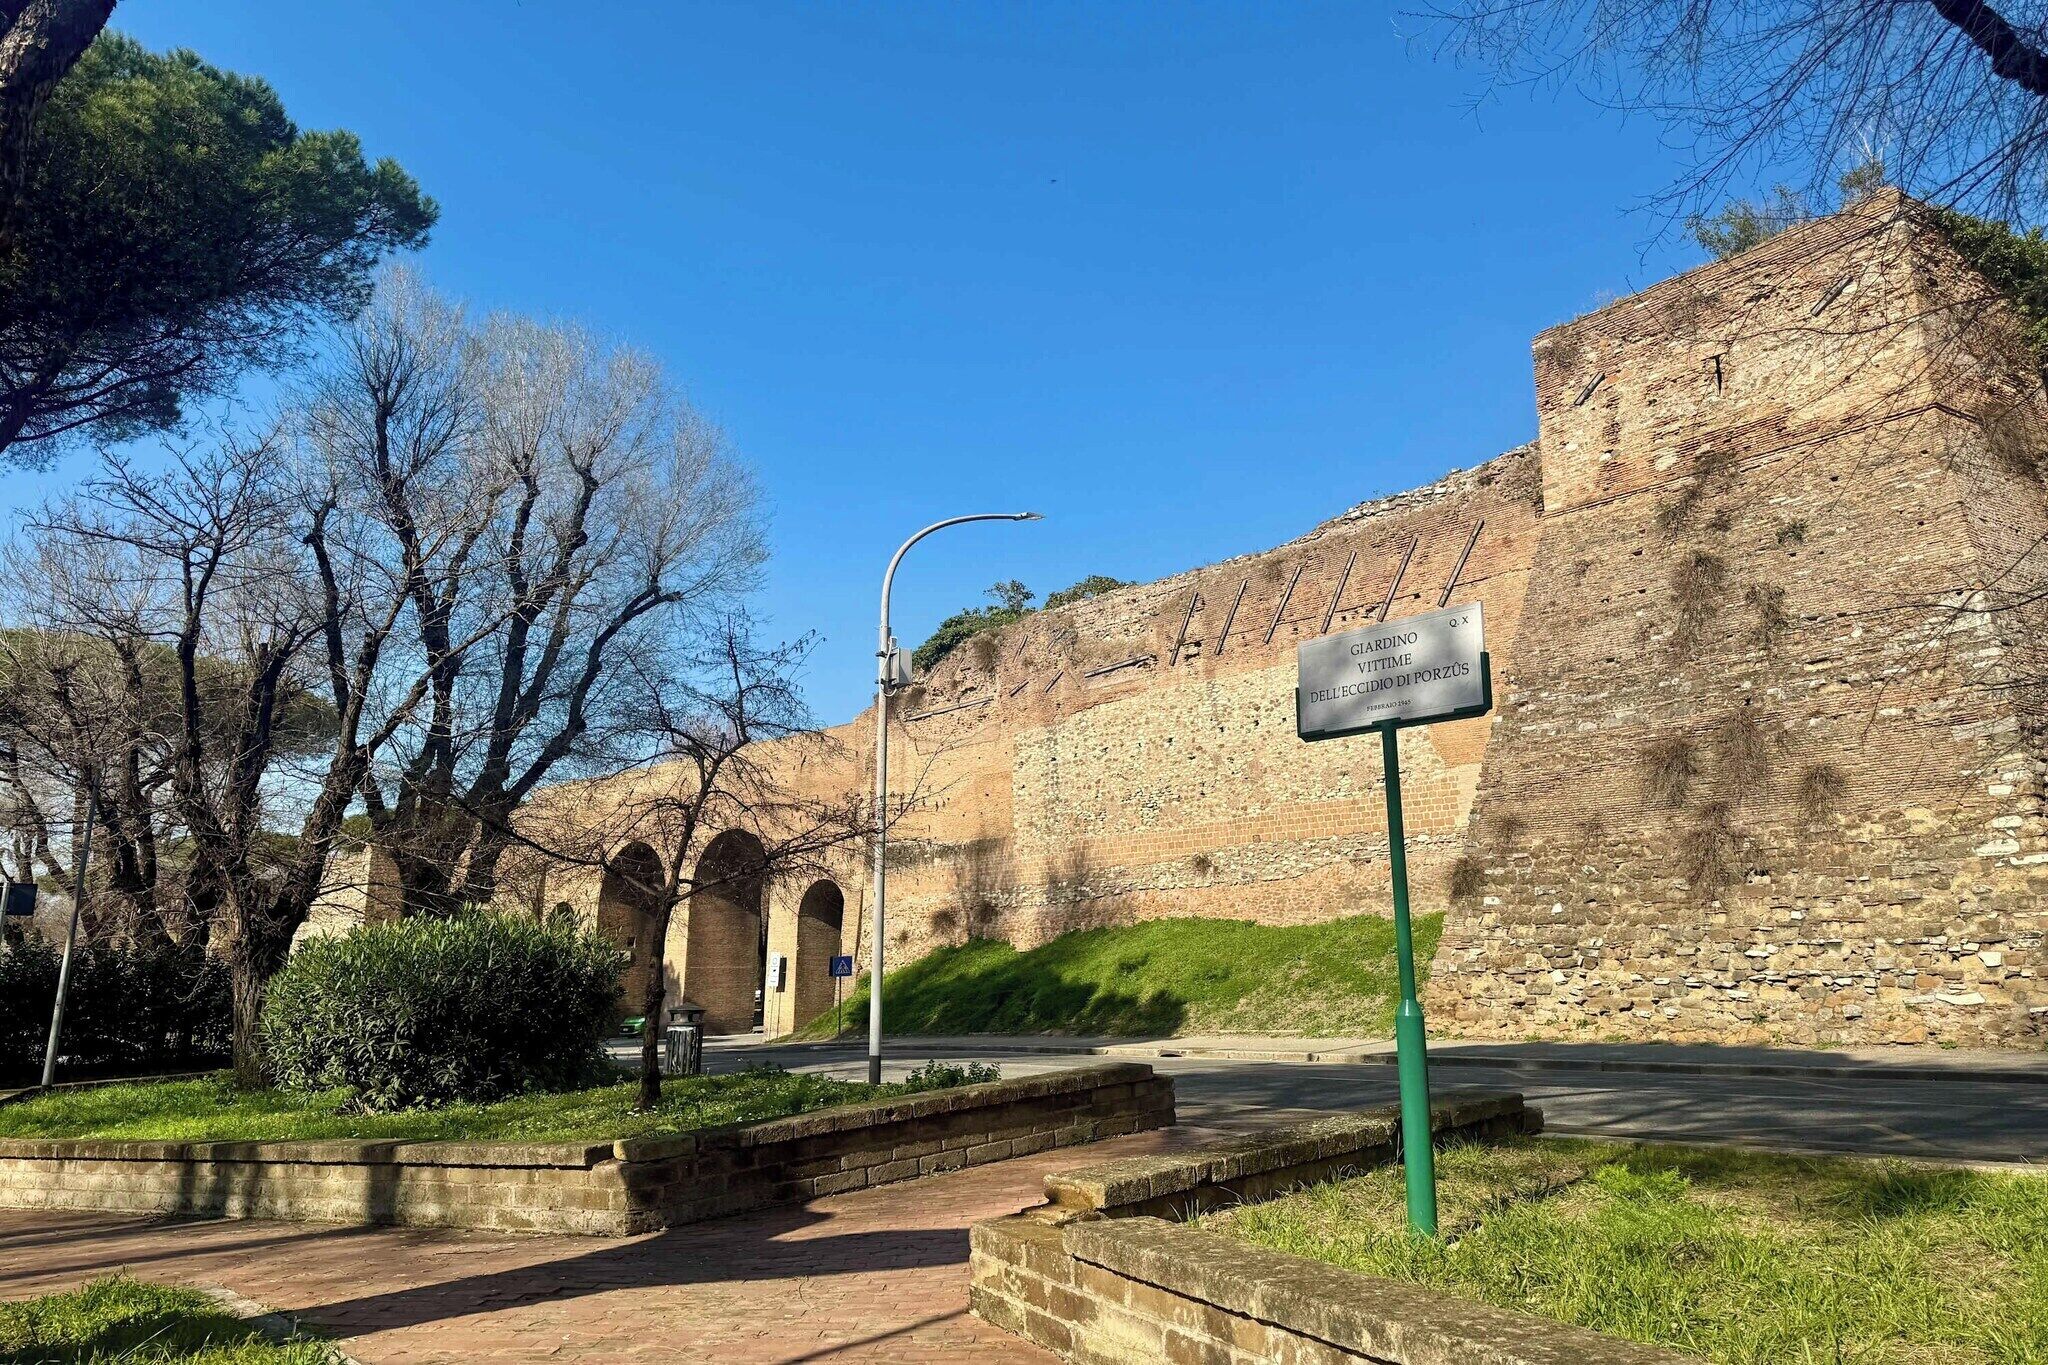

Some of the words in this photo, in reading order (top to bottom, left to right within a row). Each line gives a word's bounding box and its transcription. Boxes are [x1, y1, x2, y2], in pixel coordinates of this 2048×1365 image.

[1449, 618, 1460, 627] Q.
[1461, 615, 1469, 624] X
[1350, 631, 1418, 656] GIARDINO
[1357, 653, 1412, 674] VITTIME
[1310, 676, 1394, 704] DELL'ECCIDIO
[1396, 674, 1410, 687] DI
[1414, 661, 1470, 684] PORZÛS
